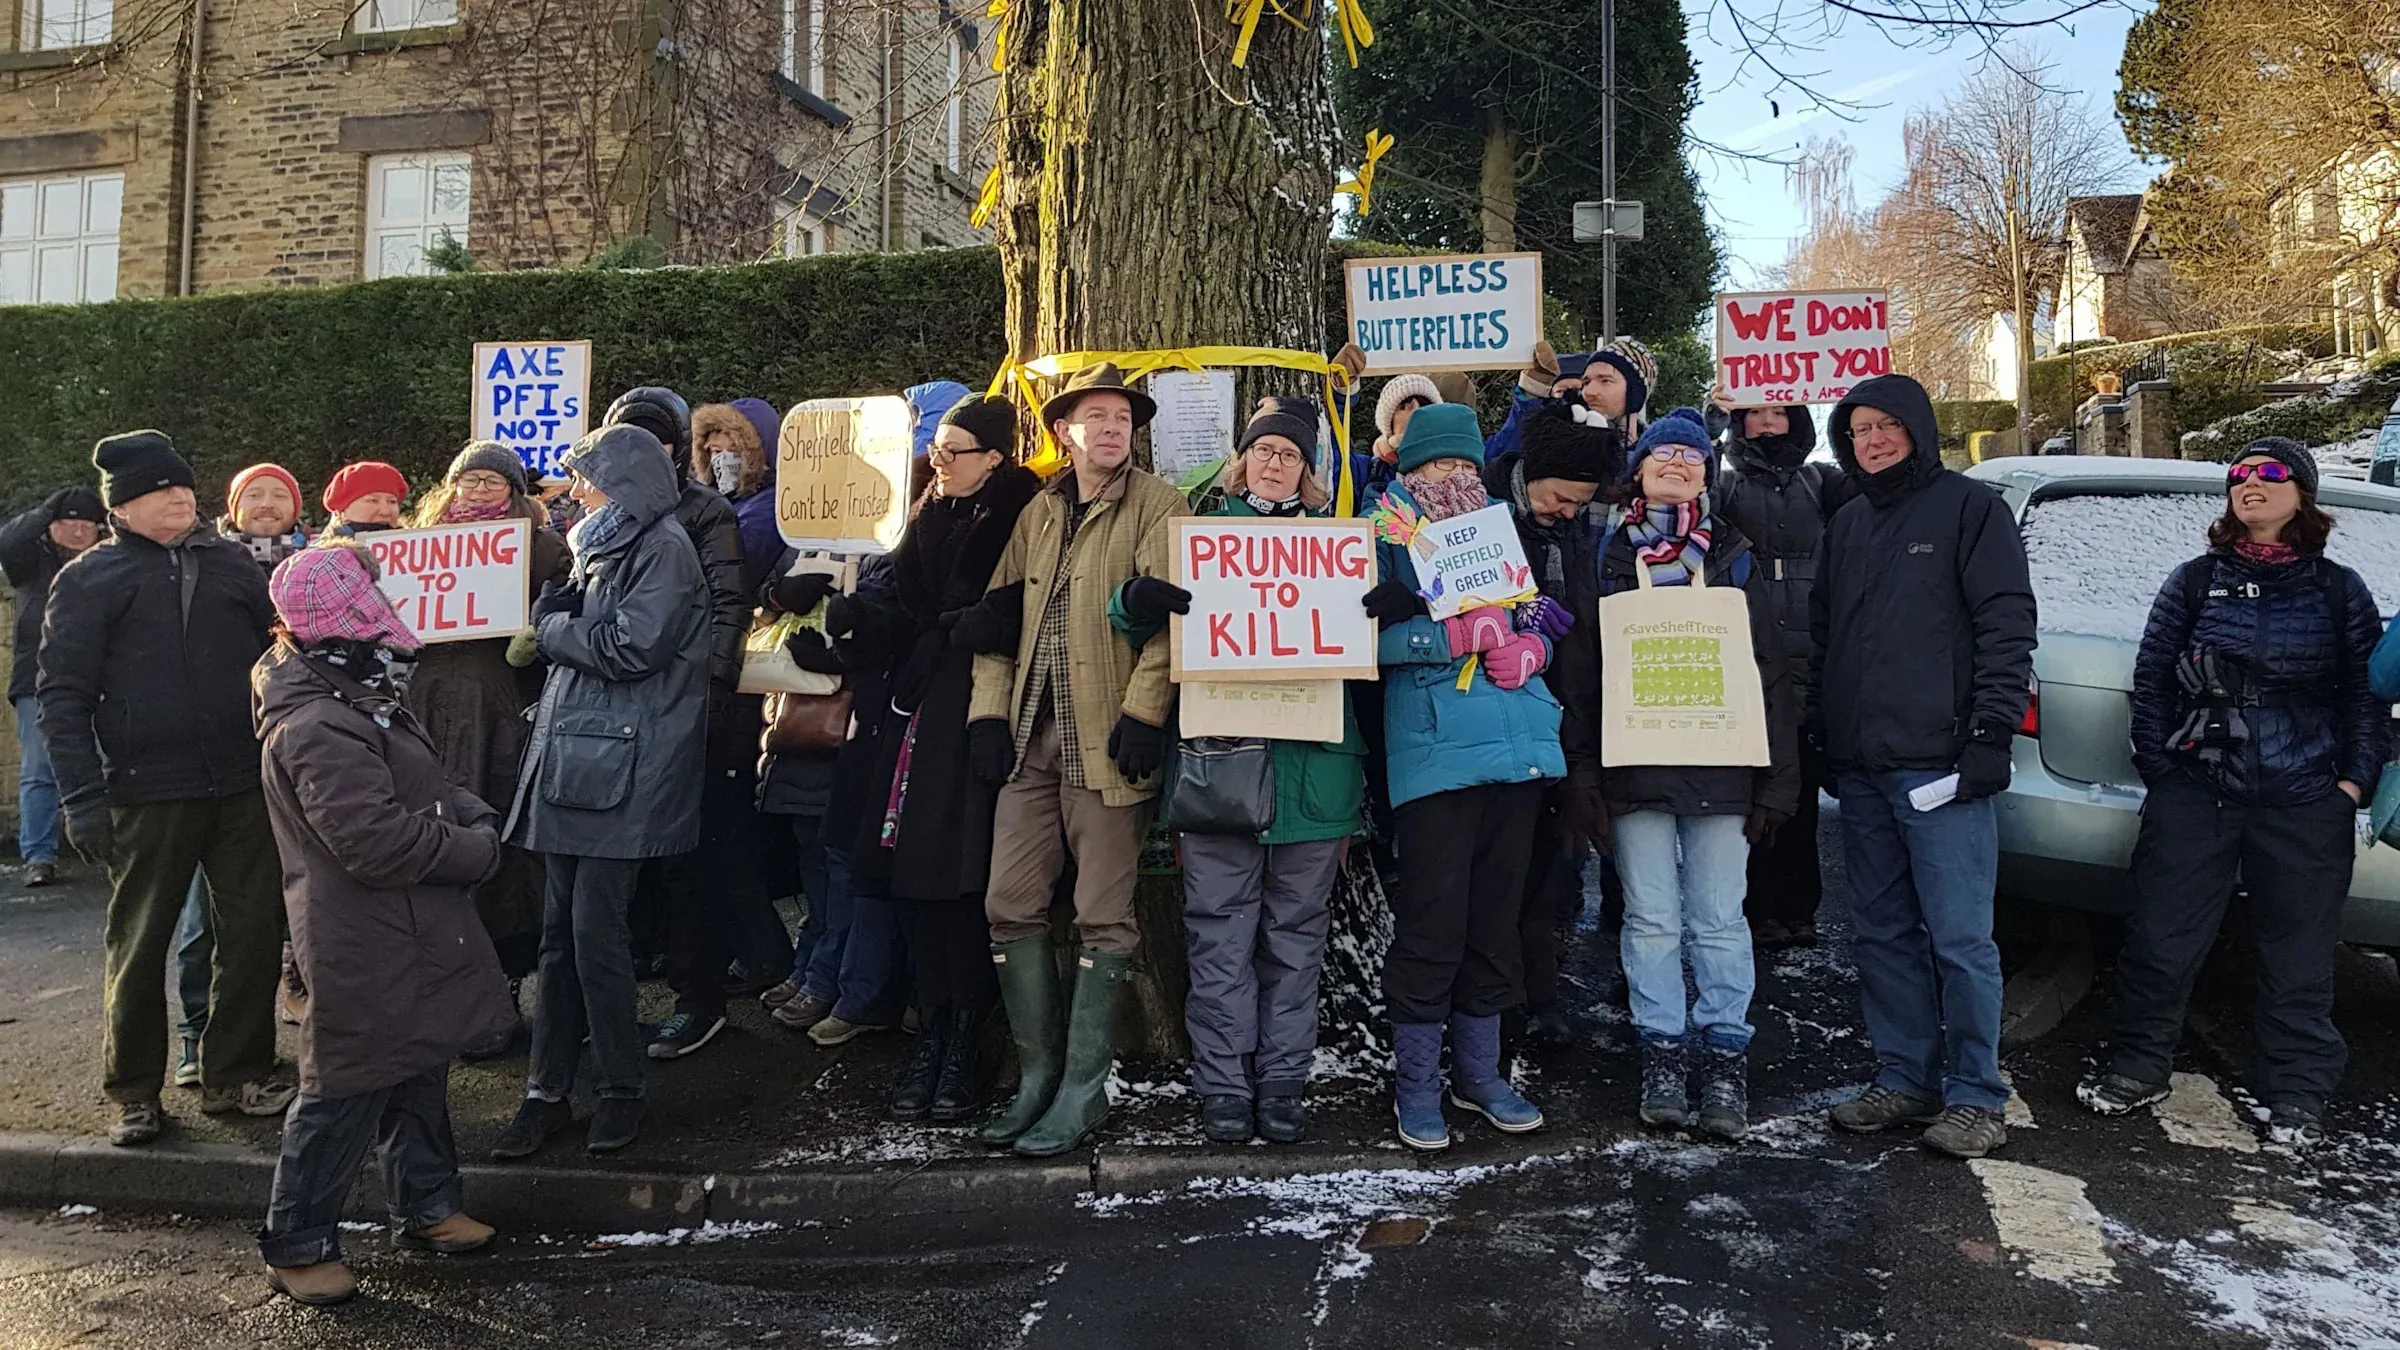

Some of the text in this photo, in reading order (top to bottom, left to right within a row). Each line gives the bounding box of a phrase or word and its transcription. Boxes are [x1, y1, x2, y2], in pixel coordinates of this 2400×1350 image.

[1367, 260, 1508, 301] HELPLESS
[1357, 309, 1509, 352] BUTTERFLIES
[1726, 298, 1796, 341] WE
[487, 347, 566, 379] AXE
[1723, 347, 1890, 389] TRUST YOU
[495, 420, 560, 440] NOT
[783, 426, 855, 472] Sheffield
[780, 481, 891, 522] Can't be Trusted
[370, 528, 518, 576] PRUNING
[1190, 534, 1369, 580] PRUNING
[1444, 526, 1478, 547] KEEP
[1435, 543, 1504, 574] SHEFFIELD
[417, 572, 457, 592] TO
[1250, 582, 1300, 608] TO
[1455, 567, 1499, 593] GREEN
[1209, 609, 1344, 657] KILL
[1622, 620, 1729, 636] #SaveSheffTrees
